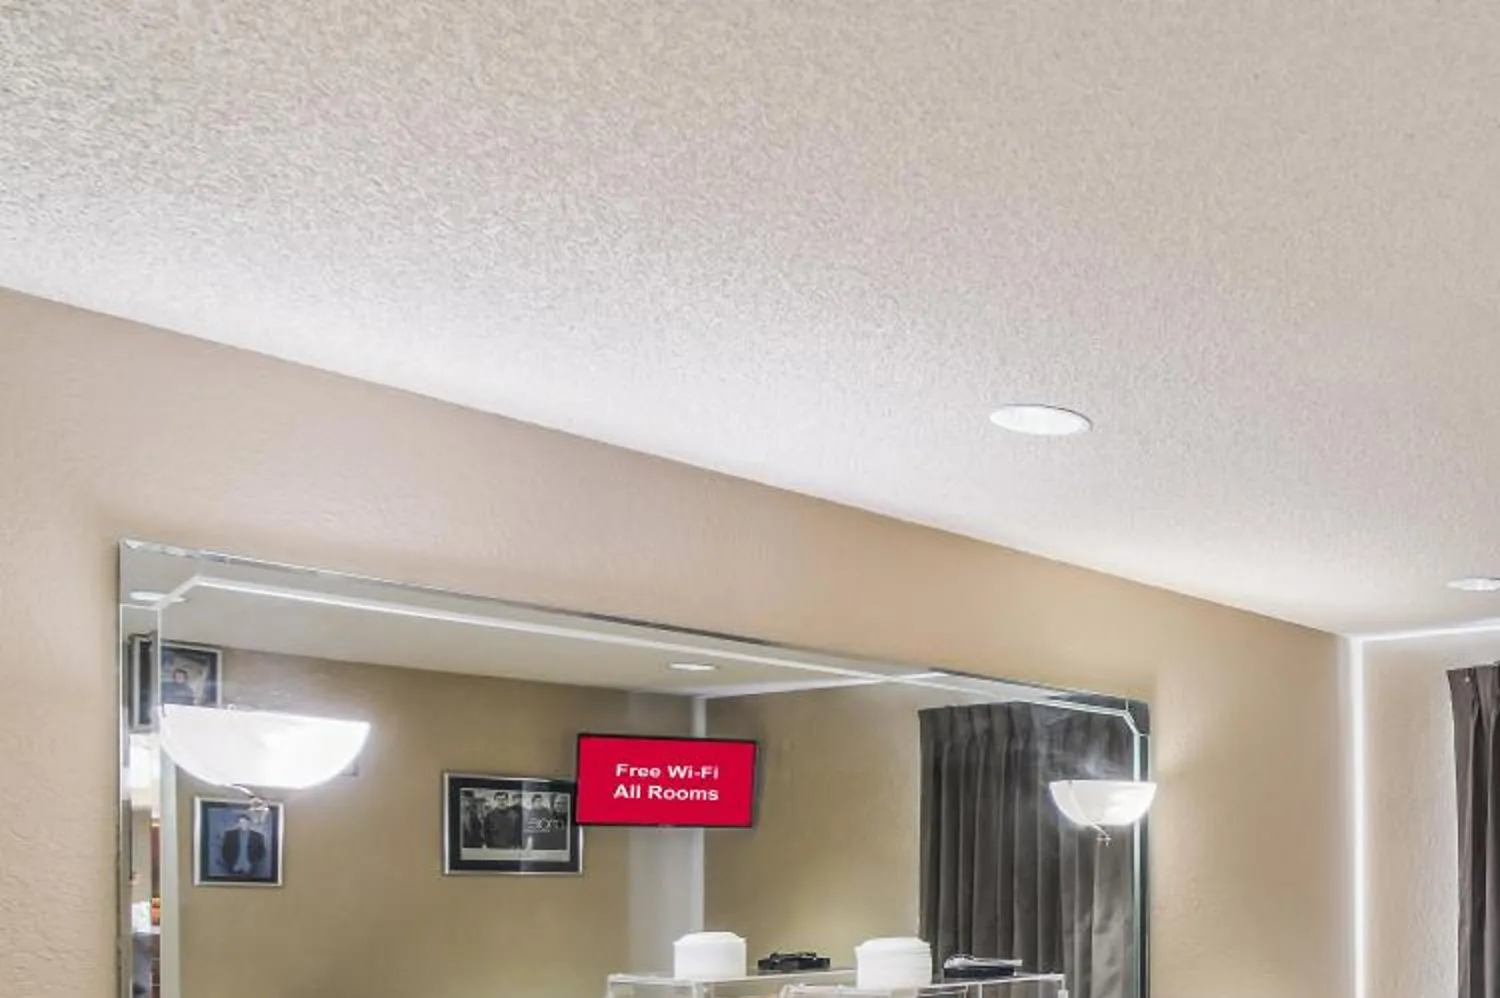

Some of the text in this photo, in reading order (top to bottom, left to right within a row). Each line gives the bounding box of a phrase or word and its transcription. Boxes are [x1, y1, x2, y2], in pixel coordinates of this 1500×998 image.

[615, 763, 719, 780] Free Wi-Fi
[612, 784, 719, 801] All Rooms
